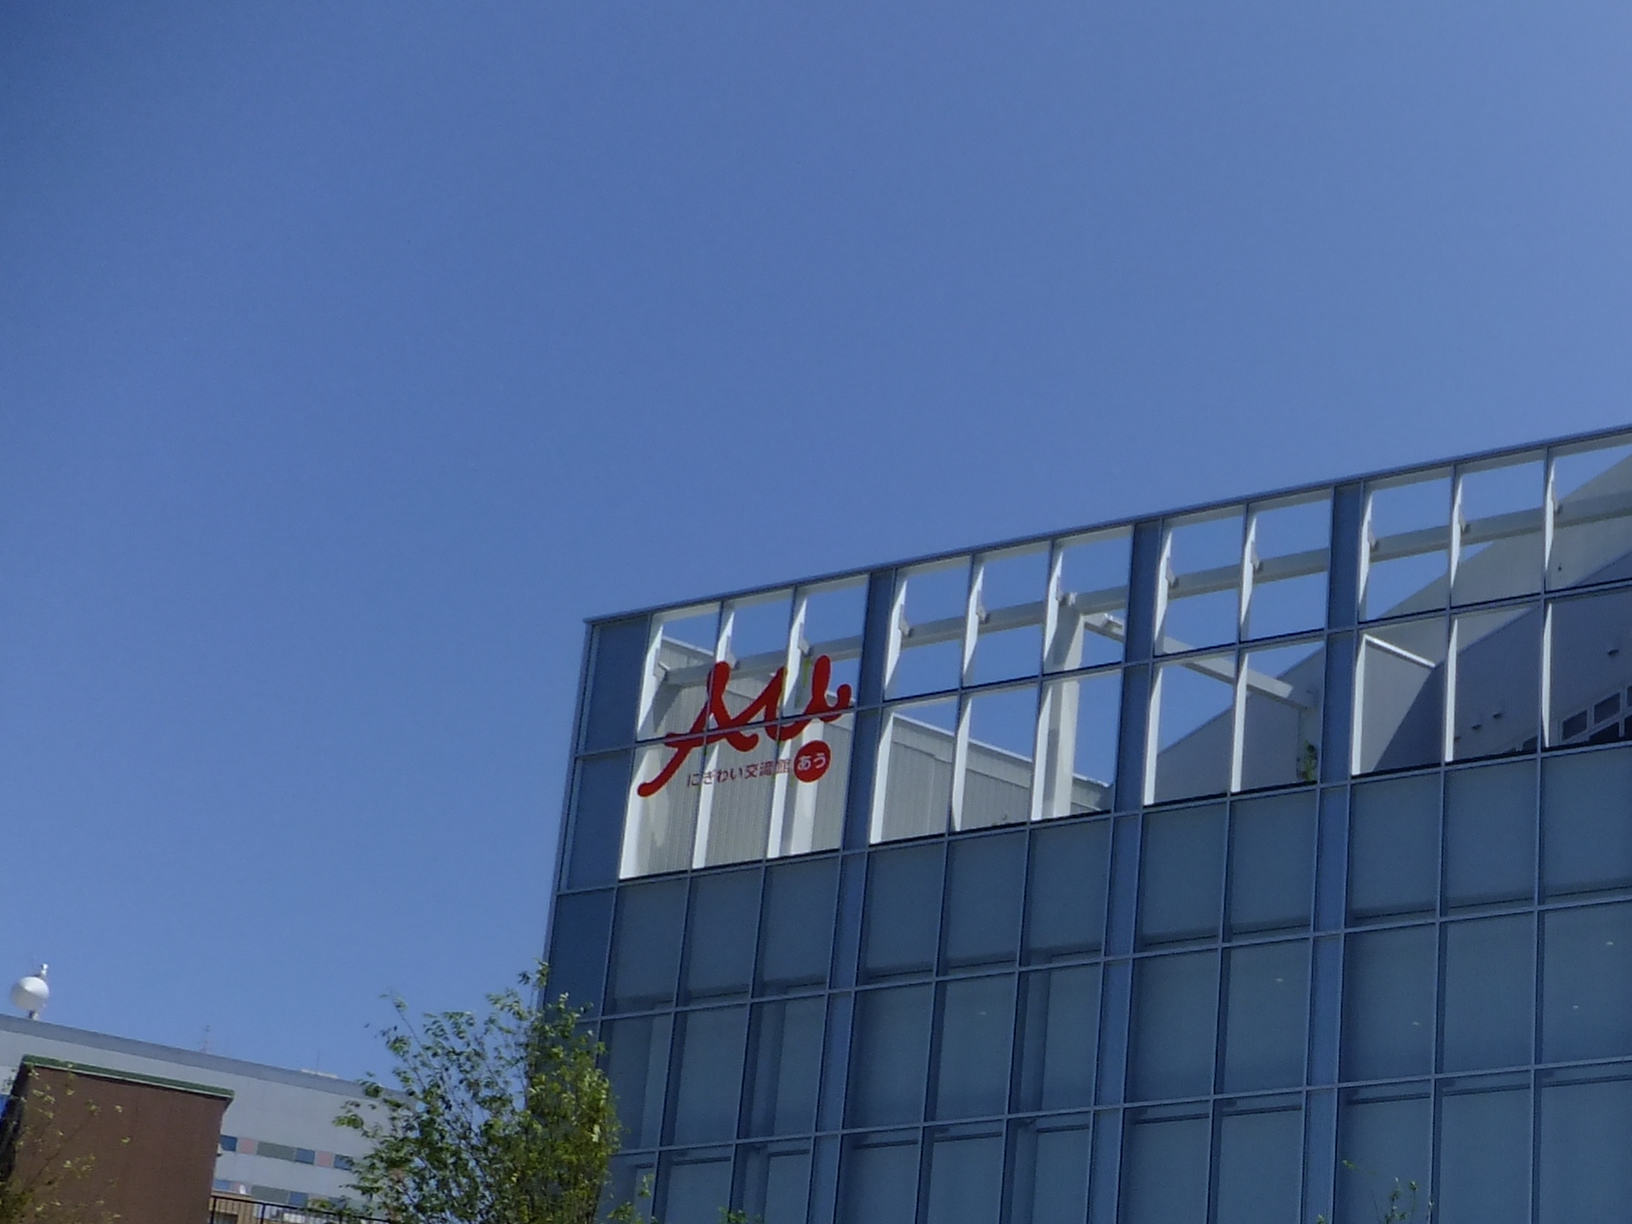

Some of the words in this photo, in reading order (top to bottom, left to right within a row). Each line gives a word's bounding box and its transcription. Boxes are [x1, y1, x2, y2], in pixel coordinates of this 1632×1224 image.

[686, 758, 791, 788] にぎわい交流館
[797, 753, 826, 771] あう
